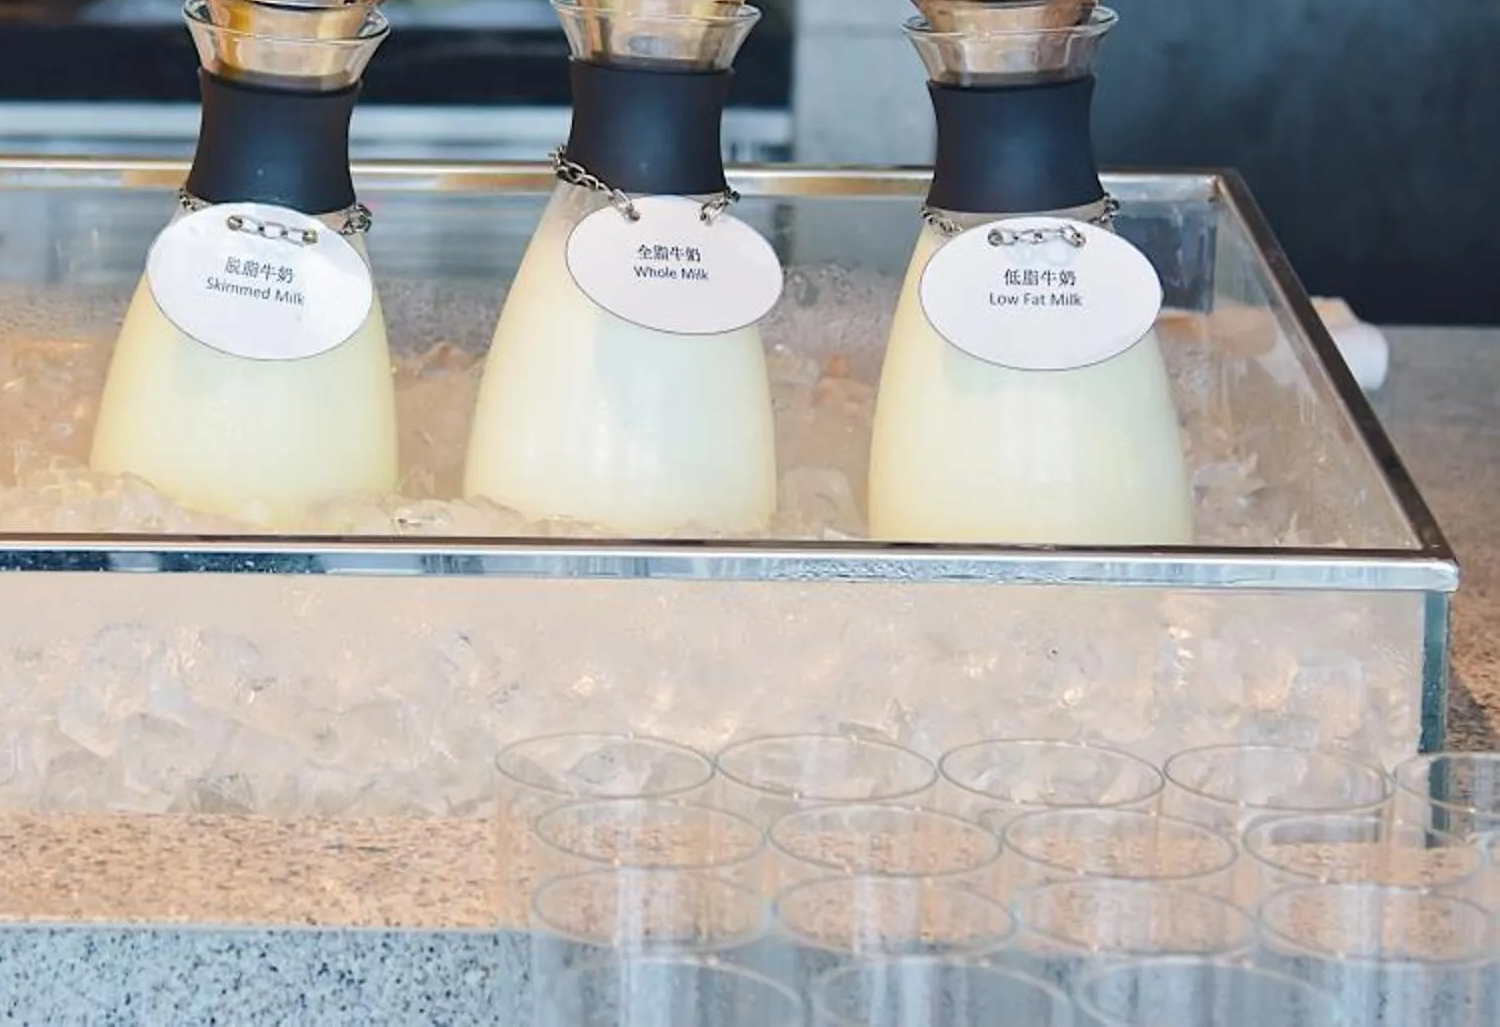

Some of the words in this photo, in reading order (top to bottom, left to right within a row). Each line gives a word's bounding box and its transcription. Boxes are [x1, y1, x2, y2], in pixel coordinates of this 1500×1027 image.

[637, 244, 701, 262] 全脂牛奶
[633, 265, 677, 279] Whole
[681, 268, 709, 280] Milk
[1003, 268, 1077, 287] 低脂牛奶
[206, 276, 271, 300] Skimmed
[275, 288, 305, 306] Milk
[988, 292, 1019, 306] Low
[1023, 293, 1046, 306] Fat
[1050, 292, 1083, 306] Milk
